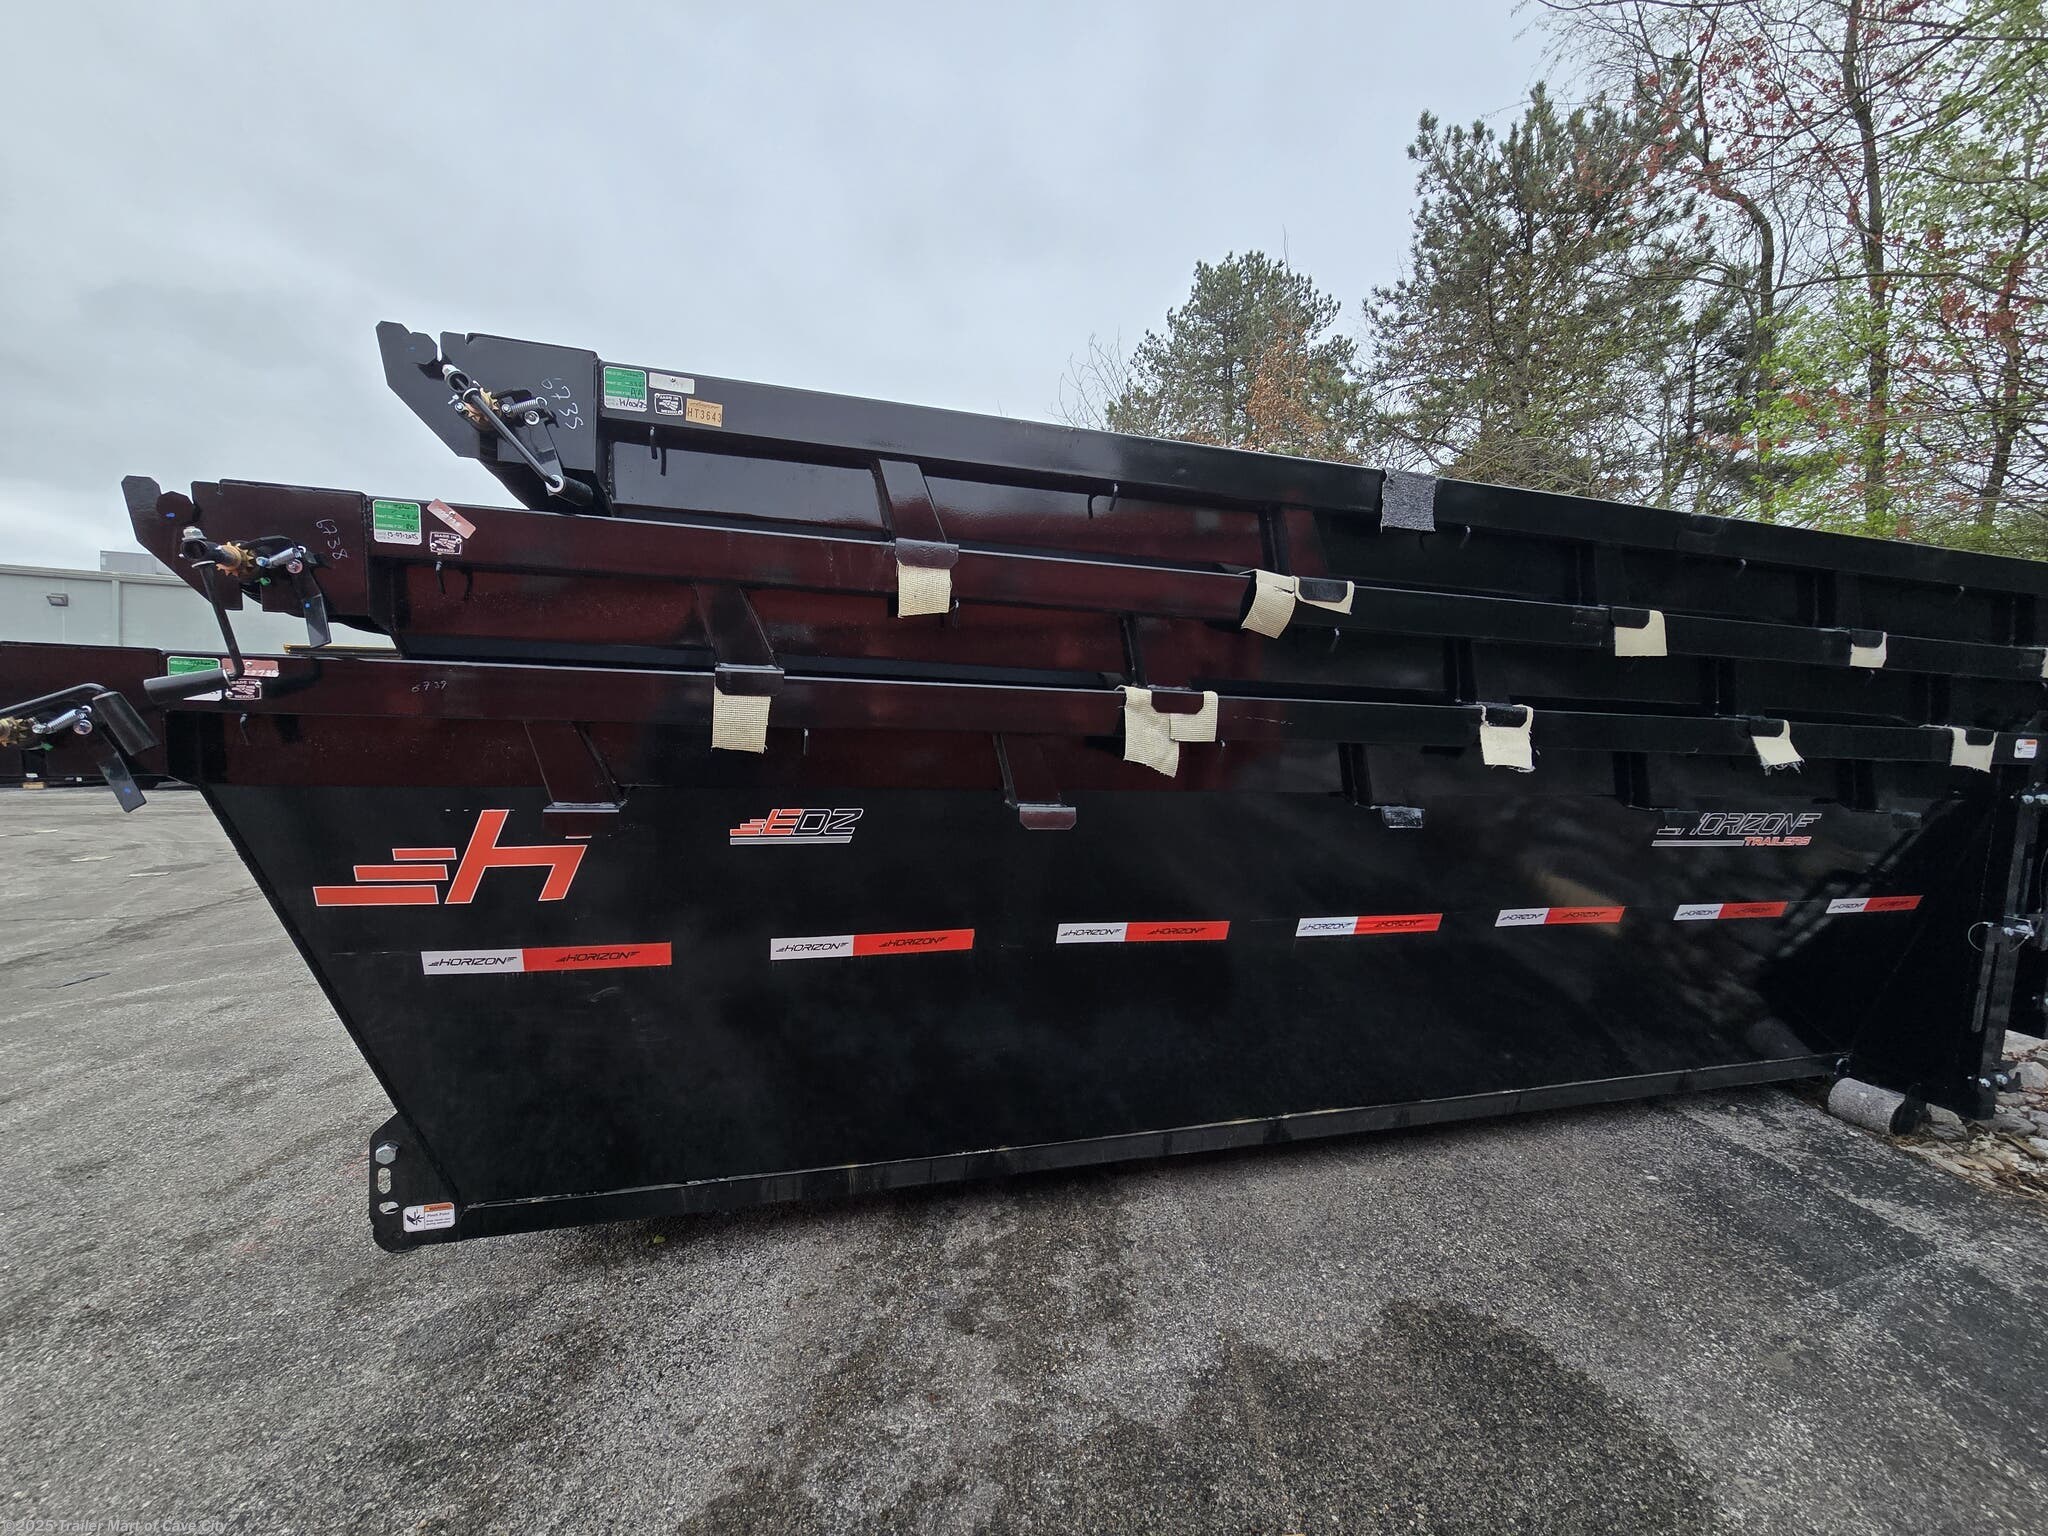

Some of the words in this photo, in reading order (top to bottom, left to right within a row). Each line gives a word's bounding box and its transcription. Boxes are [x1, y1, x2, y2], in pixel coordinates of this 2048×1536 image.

[687, 406, 721, 423] HT3643
[1744, 836, 1812, 847] TRAILERS
[1066, 928, 1115, 937] HORIZON
[782, 942, 843, 952] HORIZON
[886, 936, 942, 947] HORIZON
[436, 956, 510, 967] HORIZON
[563, 951, 633, 962] HORIZON
